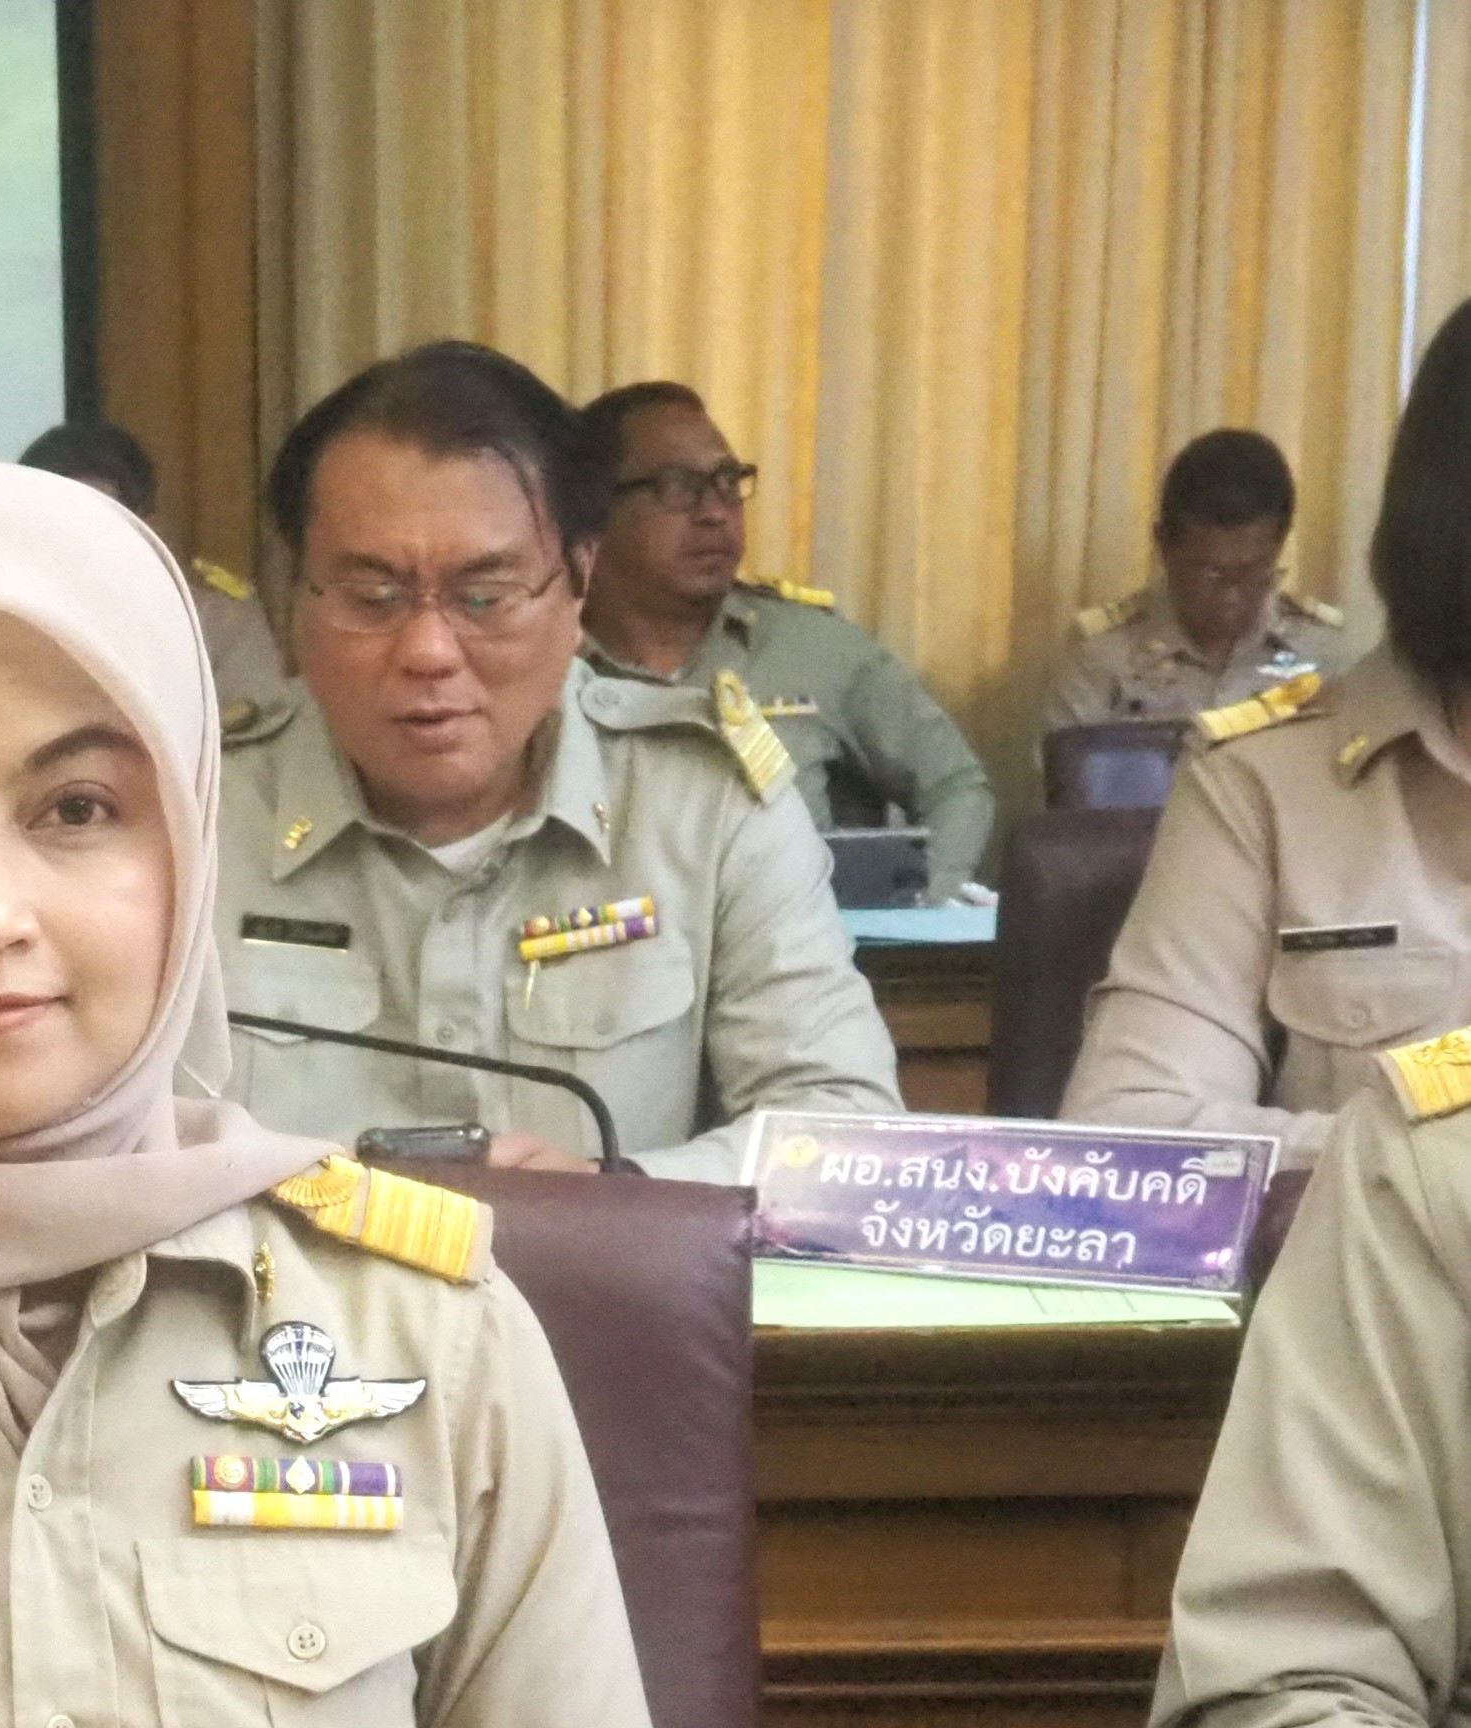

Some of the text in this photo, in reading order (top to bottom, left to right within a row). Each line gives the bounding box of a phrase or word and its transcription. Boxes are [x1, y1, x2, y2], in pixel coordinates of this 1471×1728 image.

[820, 1147, 1207, 1205] ผอ.สนง.บังคับคดี
[859, 1200, 1138, 1270] จังหวัดยะลา
